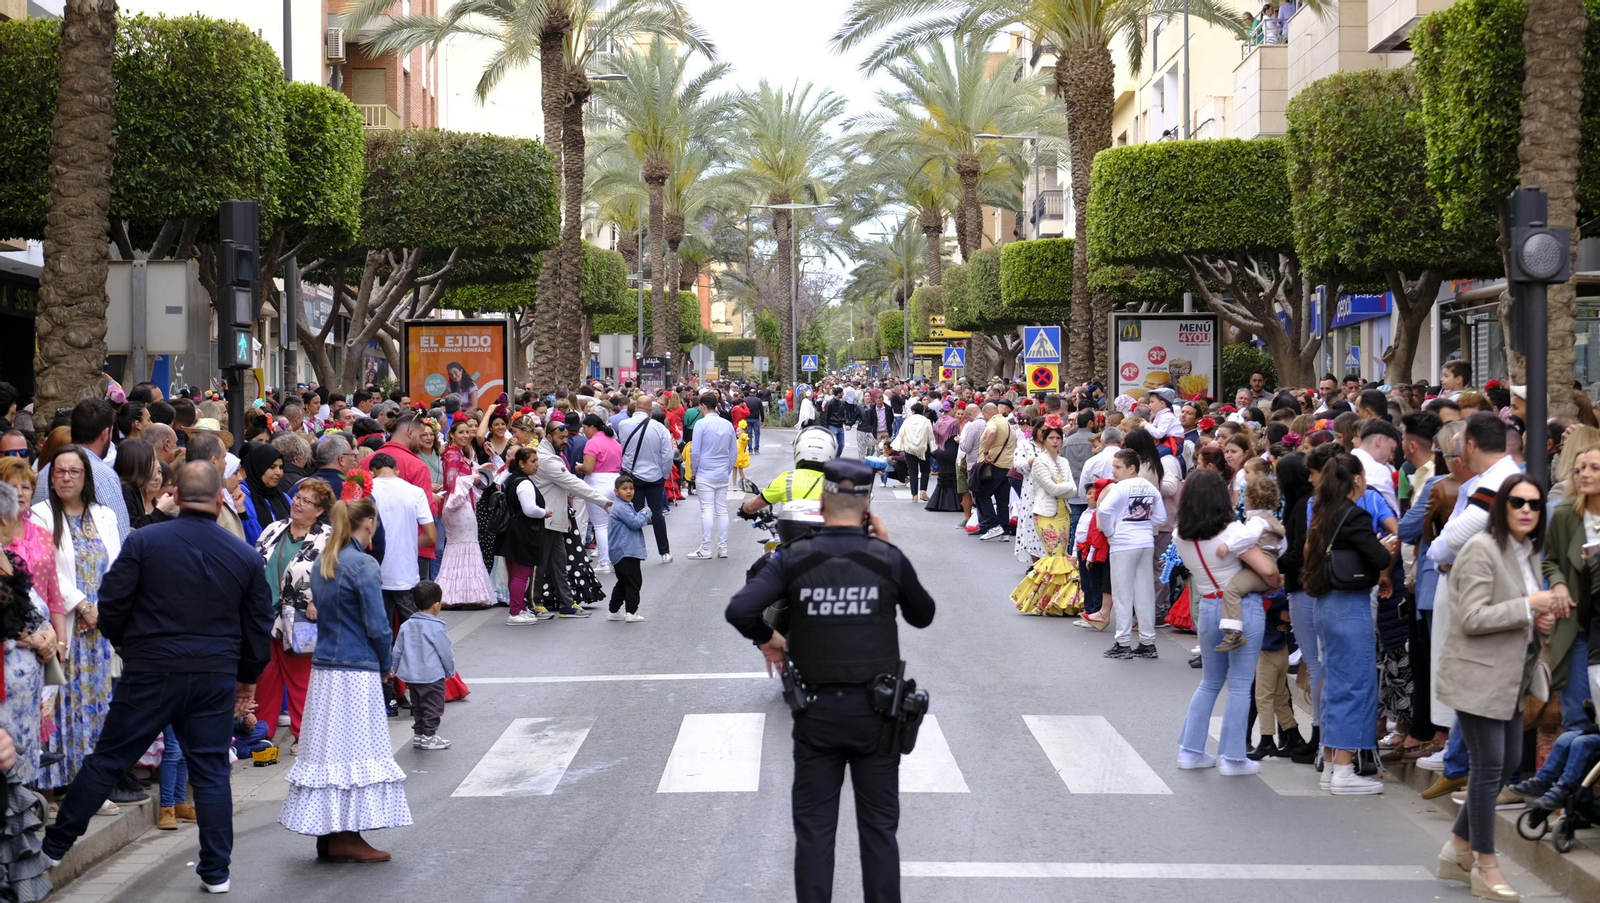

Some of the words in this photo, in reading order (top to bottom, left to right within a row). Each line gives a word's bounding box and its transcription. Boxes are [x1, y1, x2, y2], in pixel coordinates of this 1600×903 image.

[1179, 321, 1211, 332] MENÚ
[420, 336, 438, 347] EL
[445, 336, 491, 347] EJIDO
[1179, 333, 1210, 342] 4YOU
[800, 587, 878, 600] POLICIA
[808, 602, 871, 616] LOCAL
